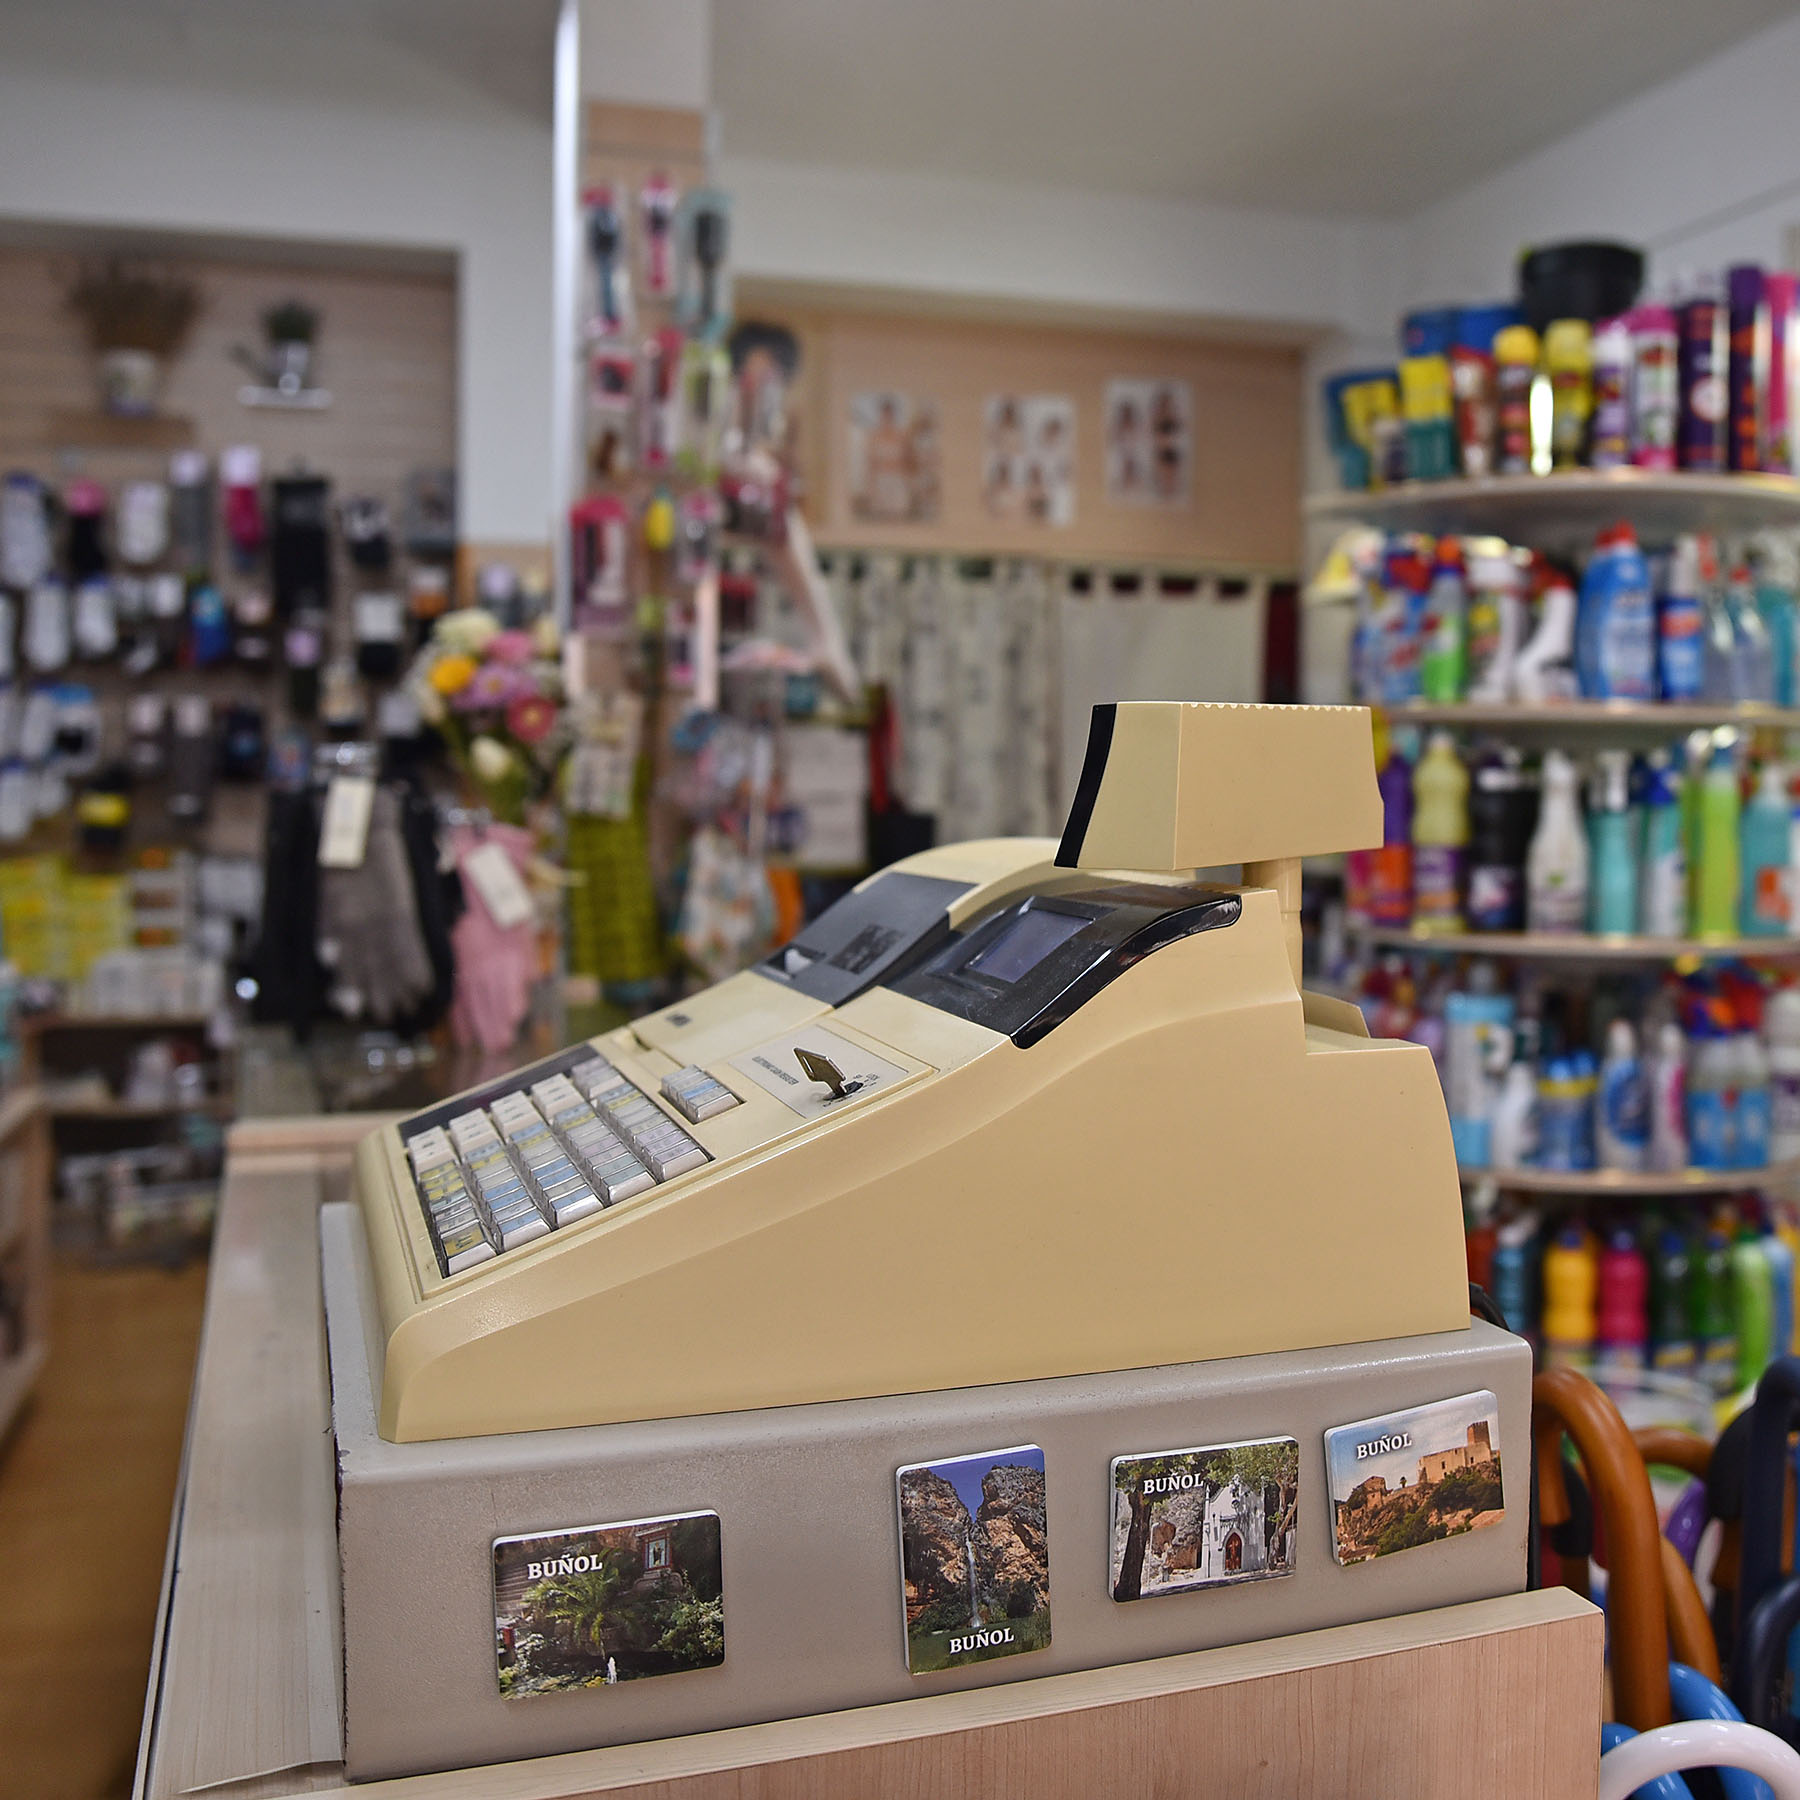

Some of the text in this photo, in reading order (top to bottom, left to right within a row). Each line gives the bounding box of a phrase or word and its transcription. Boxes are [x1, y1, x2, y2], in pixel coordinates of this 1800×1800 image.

[1356, 1432, 1412, 1459] BUÑOL
[1143, 1472, 1204, 1495] BUÑOL
[527, 1553, 603, 1580] BUÑOL
[949, 1627, 1015, 1654] BUÑOL
